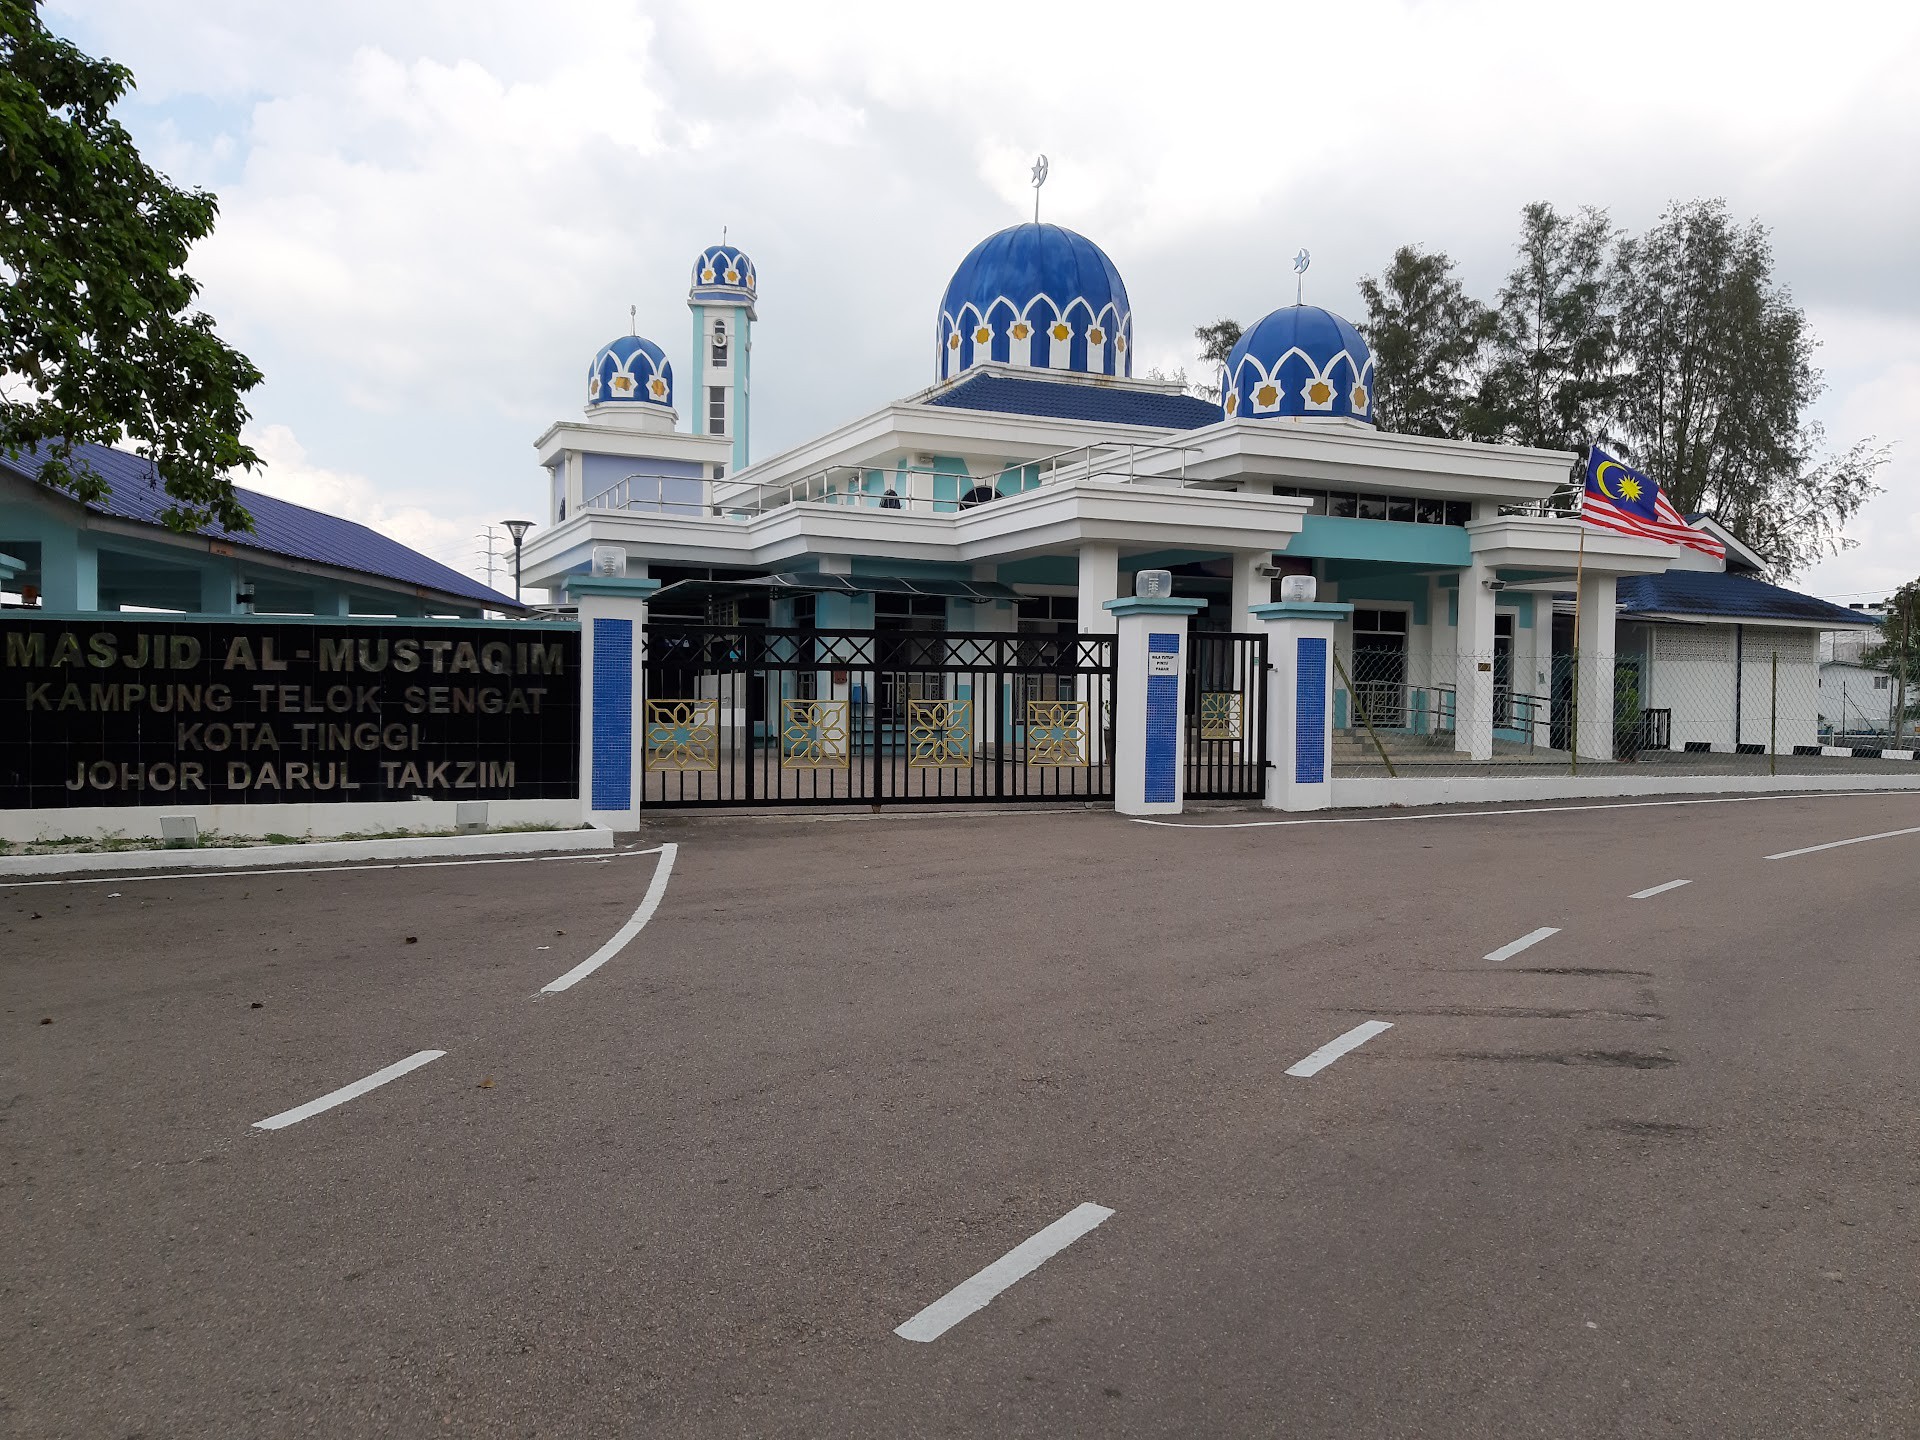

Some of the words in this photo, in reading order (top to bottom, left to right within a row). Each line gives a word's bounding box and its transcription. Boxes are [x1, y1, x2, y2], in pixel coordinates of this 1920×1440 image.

[6, 632, 201, 670] MASJID
[223, 636, 564, 676] AL-MUSTAQIM
[26, 682, 233, 713] KAMPUNG
[253, 684, 381, 713] TELOK
[404, 686, 548, 714] SENGAT
[178, 722, 280, 751] KOTA
[293, 722, 420, 751] TINGGI
[65, 761, 207, 791] JOHOR
[227, 761, 361, 790] DARUL
[380, 761, 516, 789] TAKZIM
